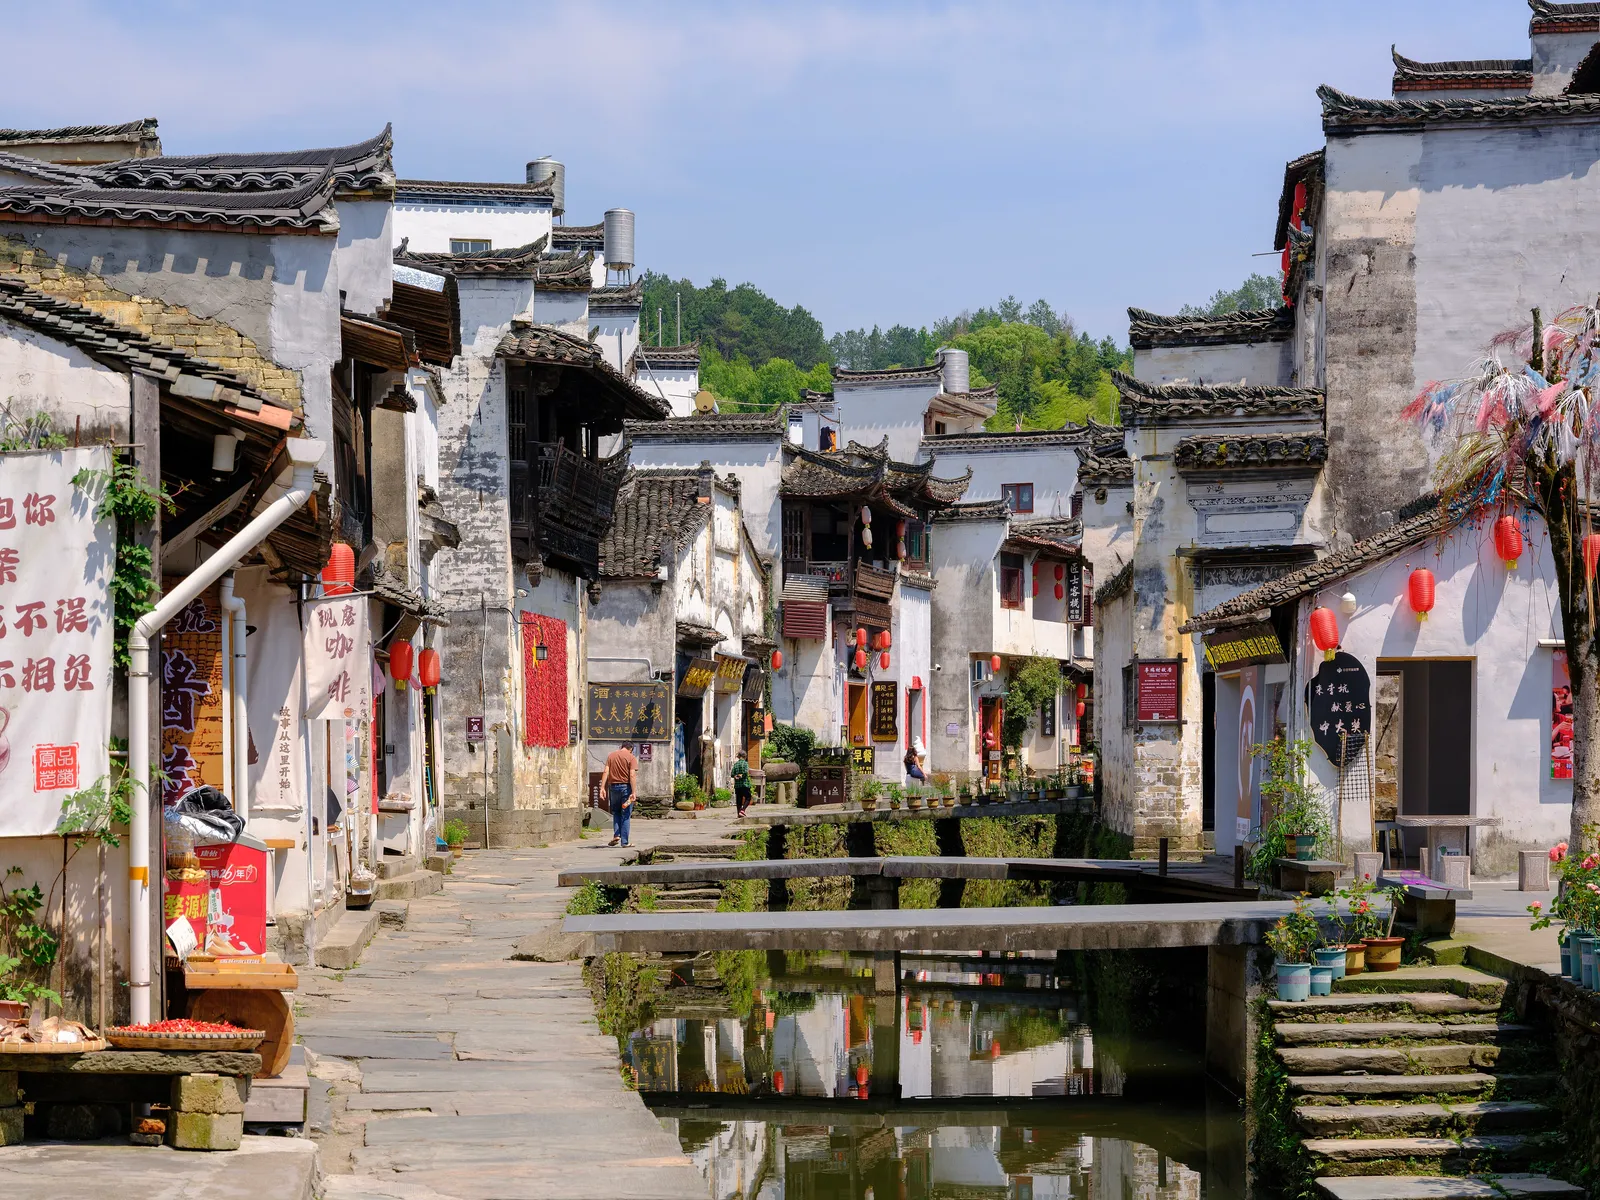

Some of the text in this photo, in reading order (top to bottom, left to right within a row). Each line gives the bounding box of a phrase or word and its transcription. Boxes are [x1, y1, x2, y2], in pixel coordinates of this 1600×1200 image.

[0, 597, 89, 639] 不误
[1315, 682, 1350, 696] 来李坑
[1330, 701, 1366, 713] 献爱心
[853, 749, 873, 763] 早餐
